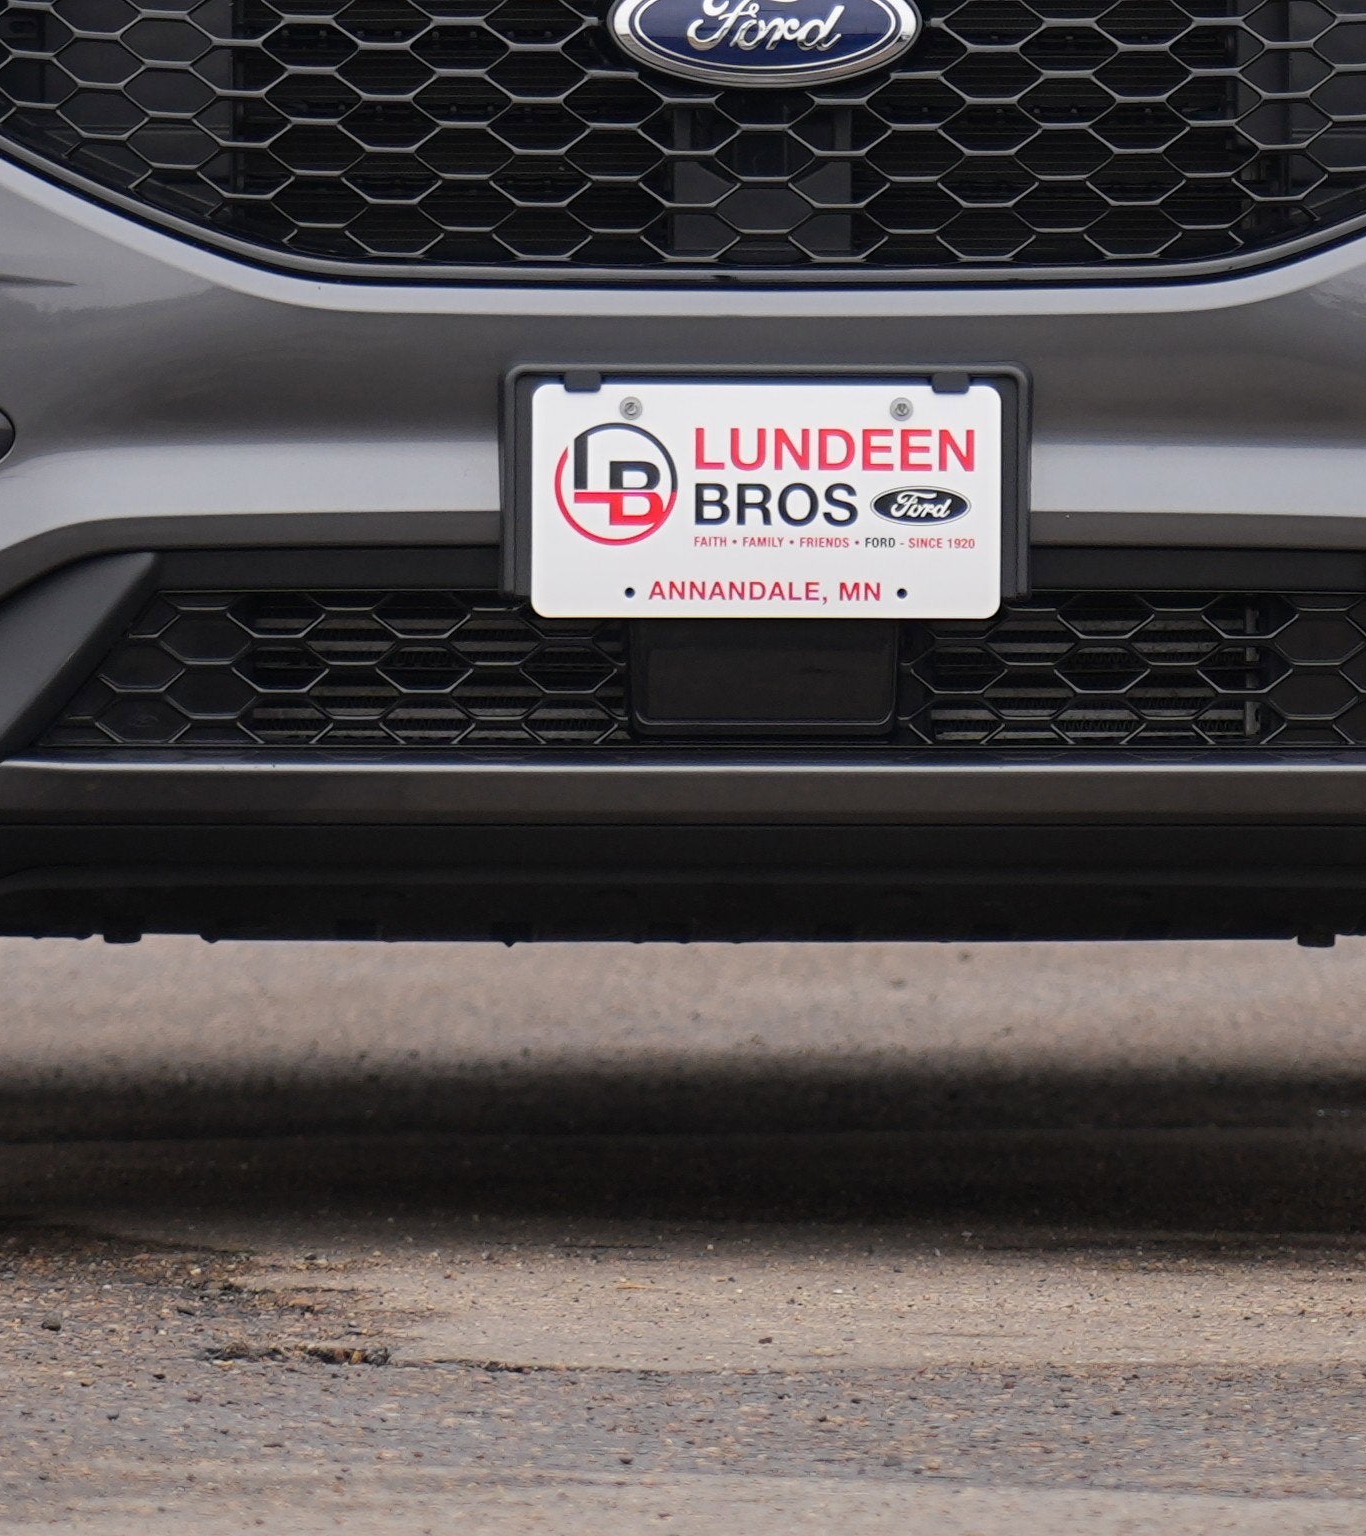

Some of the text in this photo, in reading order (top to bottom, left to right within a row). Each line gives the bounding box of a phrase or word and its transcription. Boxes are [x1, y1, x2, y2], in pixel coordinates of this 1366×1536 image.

[694, 427, 976, 473] LUNDEEN
[693, 482, 859, 527] BROS
[889, 491, 951, 520] Ford
[693, 536, 976, 550] FAITH FAMILY FRIENDS FORD SINCE 1920
[648, 581, 882, 605] ANNANDALE, MN
